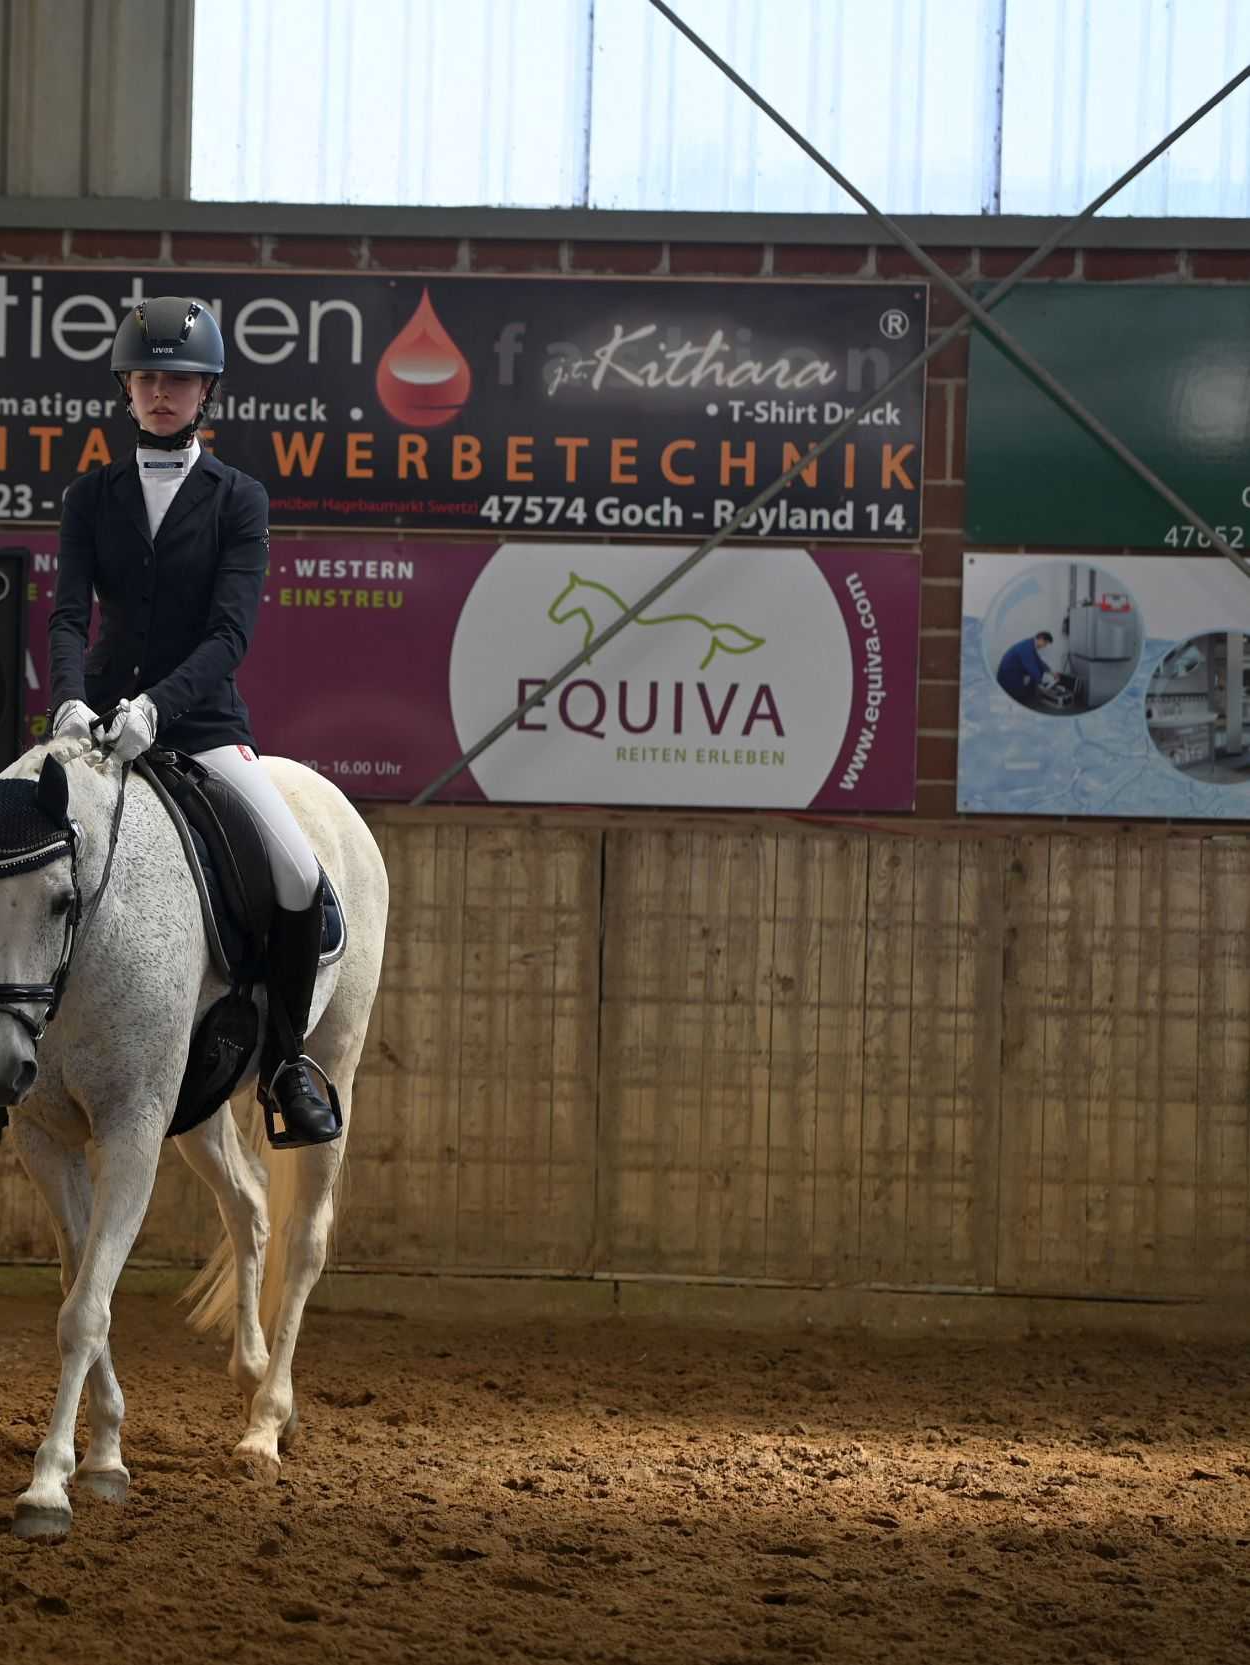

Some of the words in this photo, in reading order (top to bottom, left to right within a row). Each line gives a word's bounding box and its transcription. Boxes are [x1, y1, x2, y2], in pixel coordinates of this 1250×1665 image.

[591, 323, 838, 392] Kithara
[208, 397, 327, 422] aldruck
[729, 401, 818, 425] T-Shirt
[271, 431, 916, 491] WERBETECHNIK
[480, 496, 587, 525] 47574
[596, 496, 683, 527] Goch
[865, 504, 906, 532] 14
[295, 559, 414, 580] WESTERN
[280, 588, 404, 609] EINSTREU
[839, 572, 887, 791] www.equiva.com
[516, 678, 786, 739] EQUIVA
[333, 760, 371, 775] 16.00
[375, 761, 402, 776] Uhr
[616, 746, 688, 763] REITEN
[695, 749, 786, 766] ERLEBEN
